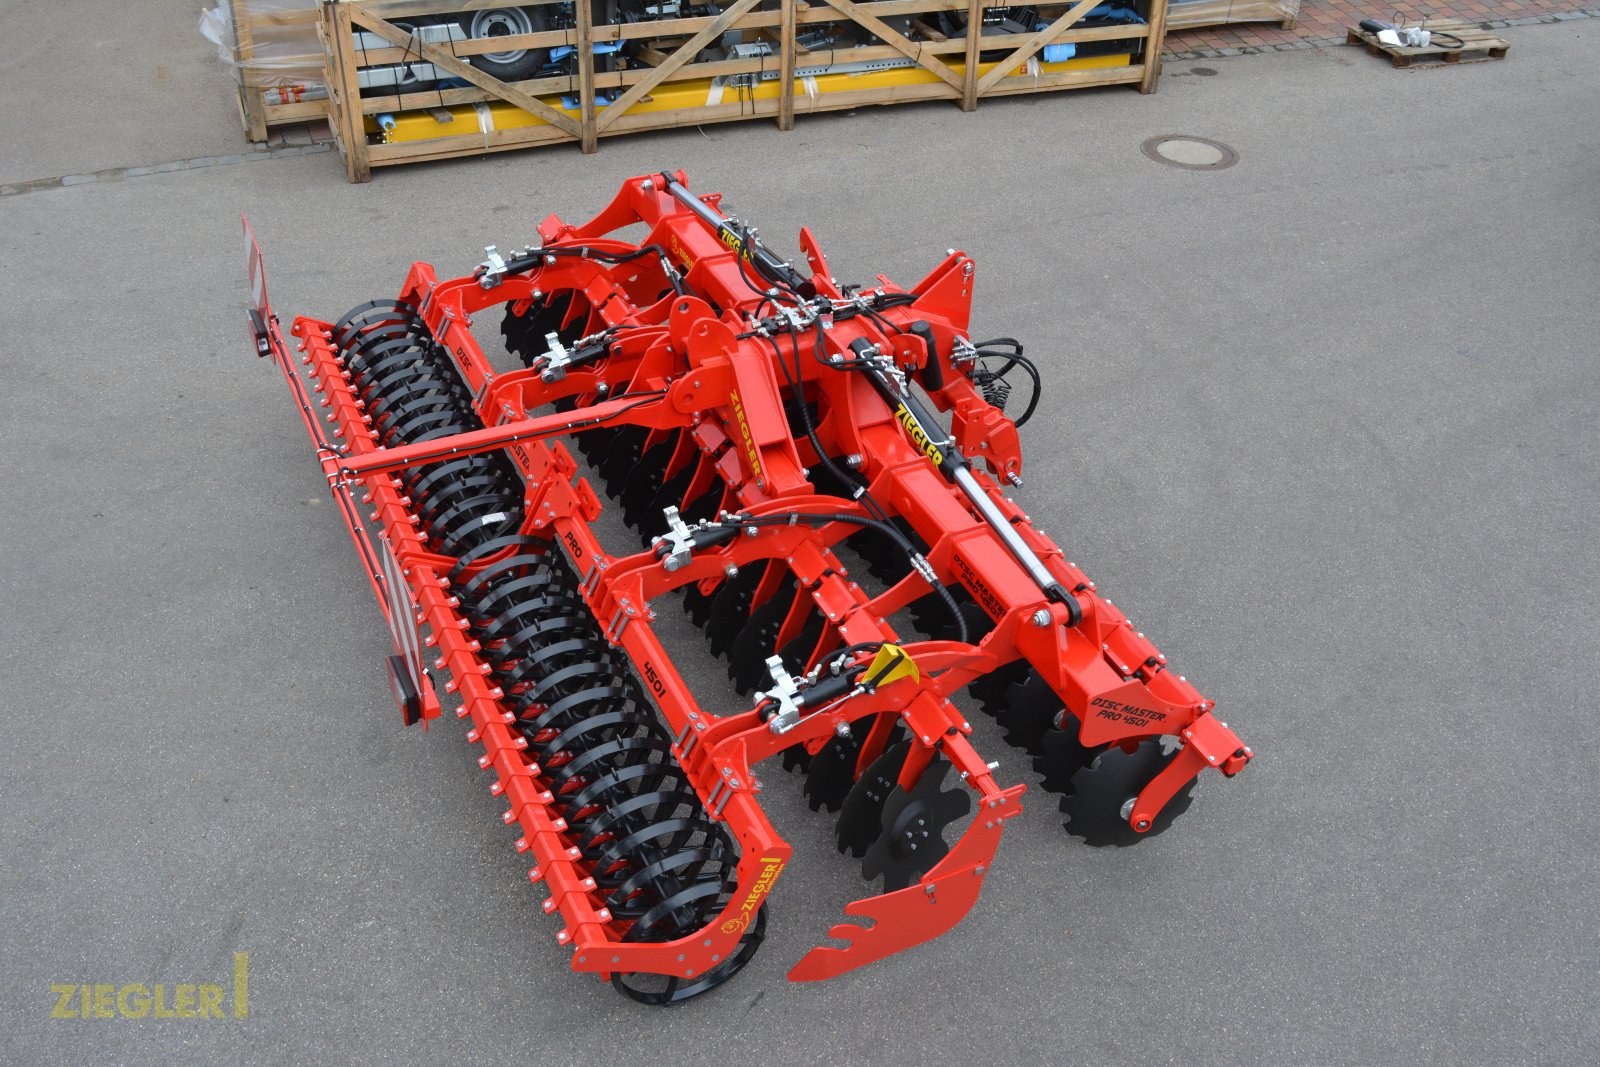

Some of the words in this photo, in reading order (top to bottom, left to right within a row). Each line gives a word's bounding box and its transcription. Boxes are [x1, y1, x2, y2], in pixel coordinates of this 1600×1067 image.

[730, 388, 761, 477] ZIEGLER
[895, 403, 943, 470] ZIEGLER
[456, 346, 473, 372] DISC
[565, 531, 583, 559] PRO
[643, 661, 667, 699] 4501
[953, 554, 976, 581] DISC
[961, 572, 979, 594] PRO
[980, 592, 1001, 619] 4501
[1090, 698, 1123, 711] DISC
[1121, 705, 1167, 721] MASTER
[1096, 710, 1122, 721] PRO
[1123, 715, 1149, 728] 4501
[741, 864, 779, 911] ZIEGLER
